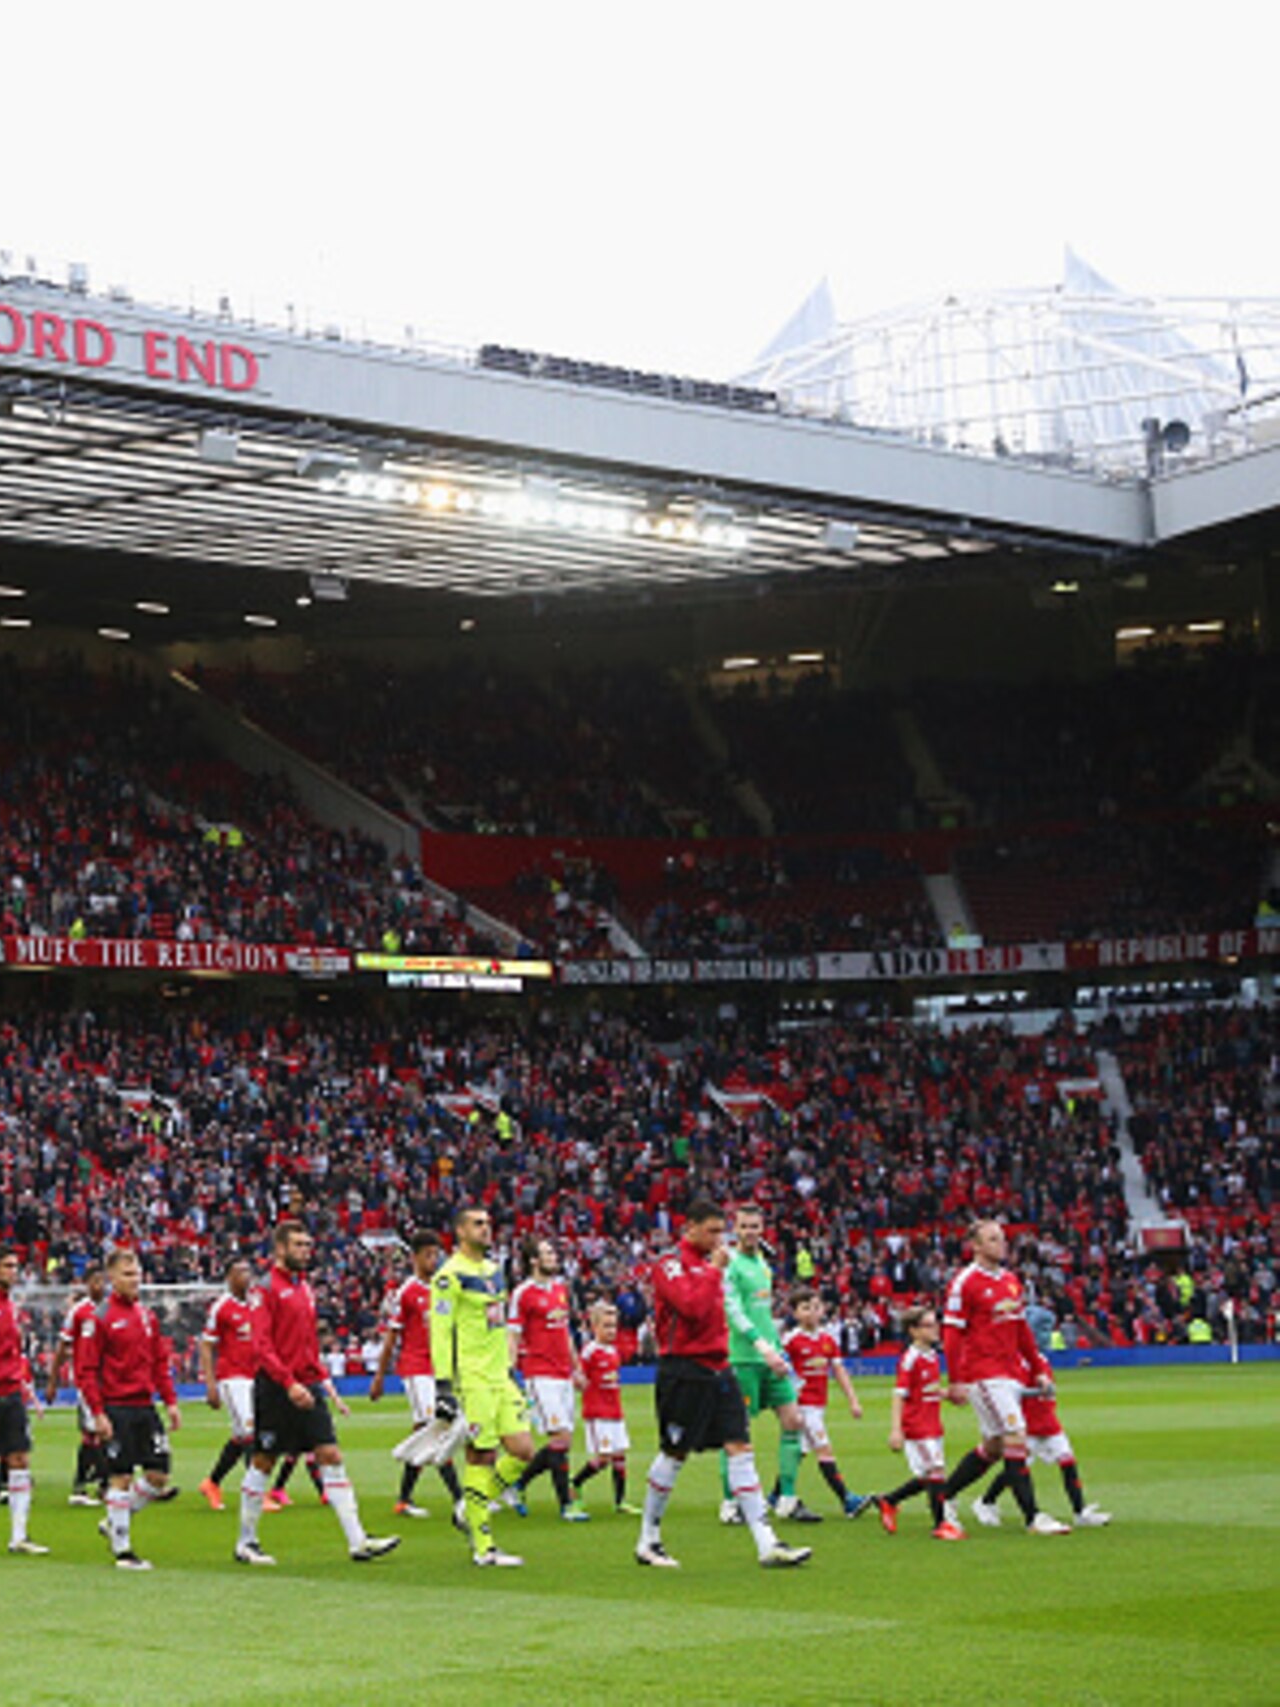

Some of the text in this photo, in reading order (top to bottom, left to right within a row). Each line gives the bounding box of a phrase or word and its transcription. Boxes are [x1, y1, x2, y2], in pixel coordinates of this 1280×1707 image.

[143, 330, 260, 392] END
[16, 937, 87, 965] MUFC
[99, 939, 147, 967] THE
[157, 942, 278, 971] RELIGION
[867, 946, 1023, 977] ADORED
[1098, 932, 1210, 967] REPUBLIC
[1219, 930, 1248, 956] OF
